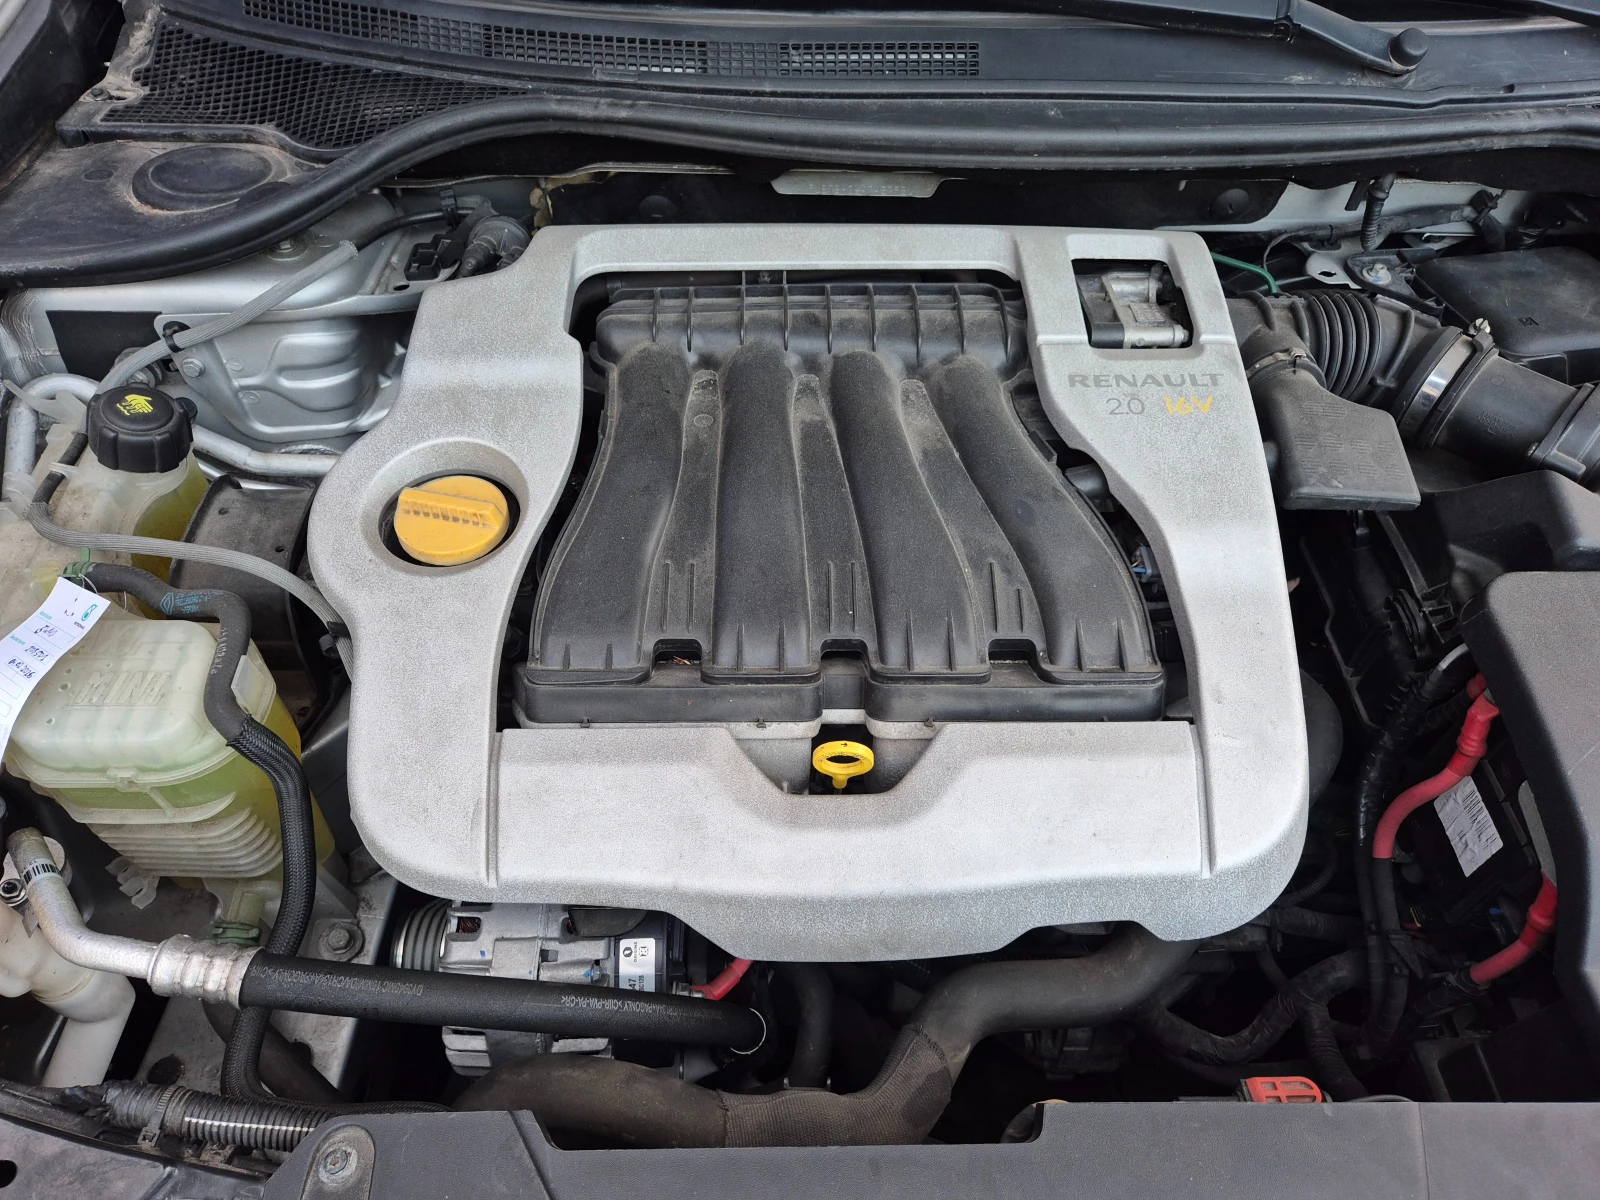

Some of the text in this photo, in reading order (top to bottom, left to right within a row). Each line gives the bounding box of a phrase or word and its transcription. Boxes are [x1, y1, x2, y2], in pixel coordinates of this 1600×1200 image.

[1067, 373, 1224, 389] RENAULT
[1105, 394, 1214, 416] 2.0 16V
[72, 670, 172, 705] MINI
